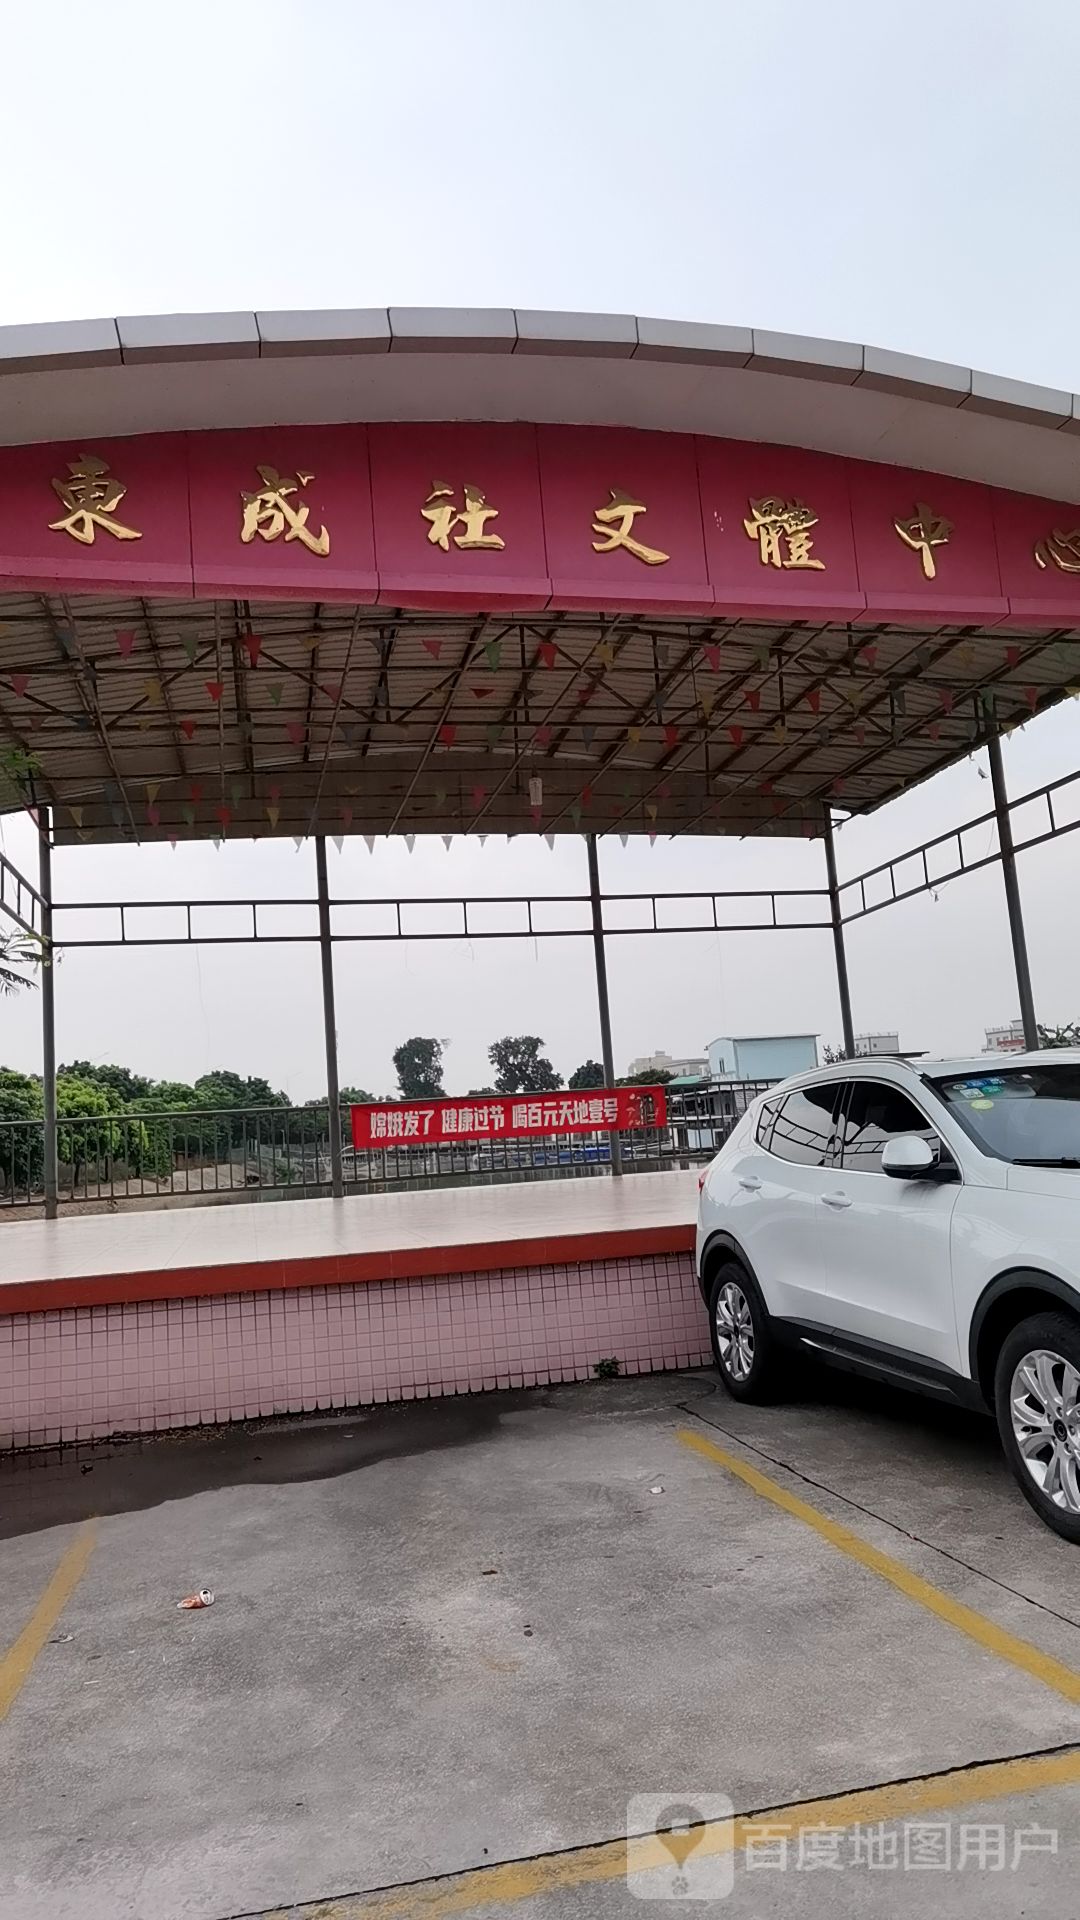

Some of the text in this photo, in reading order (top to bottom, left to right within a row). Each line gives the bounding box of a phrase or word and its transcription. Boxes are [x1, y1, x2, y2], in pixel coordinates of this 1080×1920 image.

[370, 1109, 435, 1139] 嫦娥发了
[441, 1105, 505, 1134] 健康过节
[512, 1097, 619, 1129] 喝百元天地壹号
